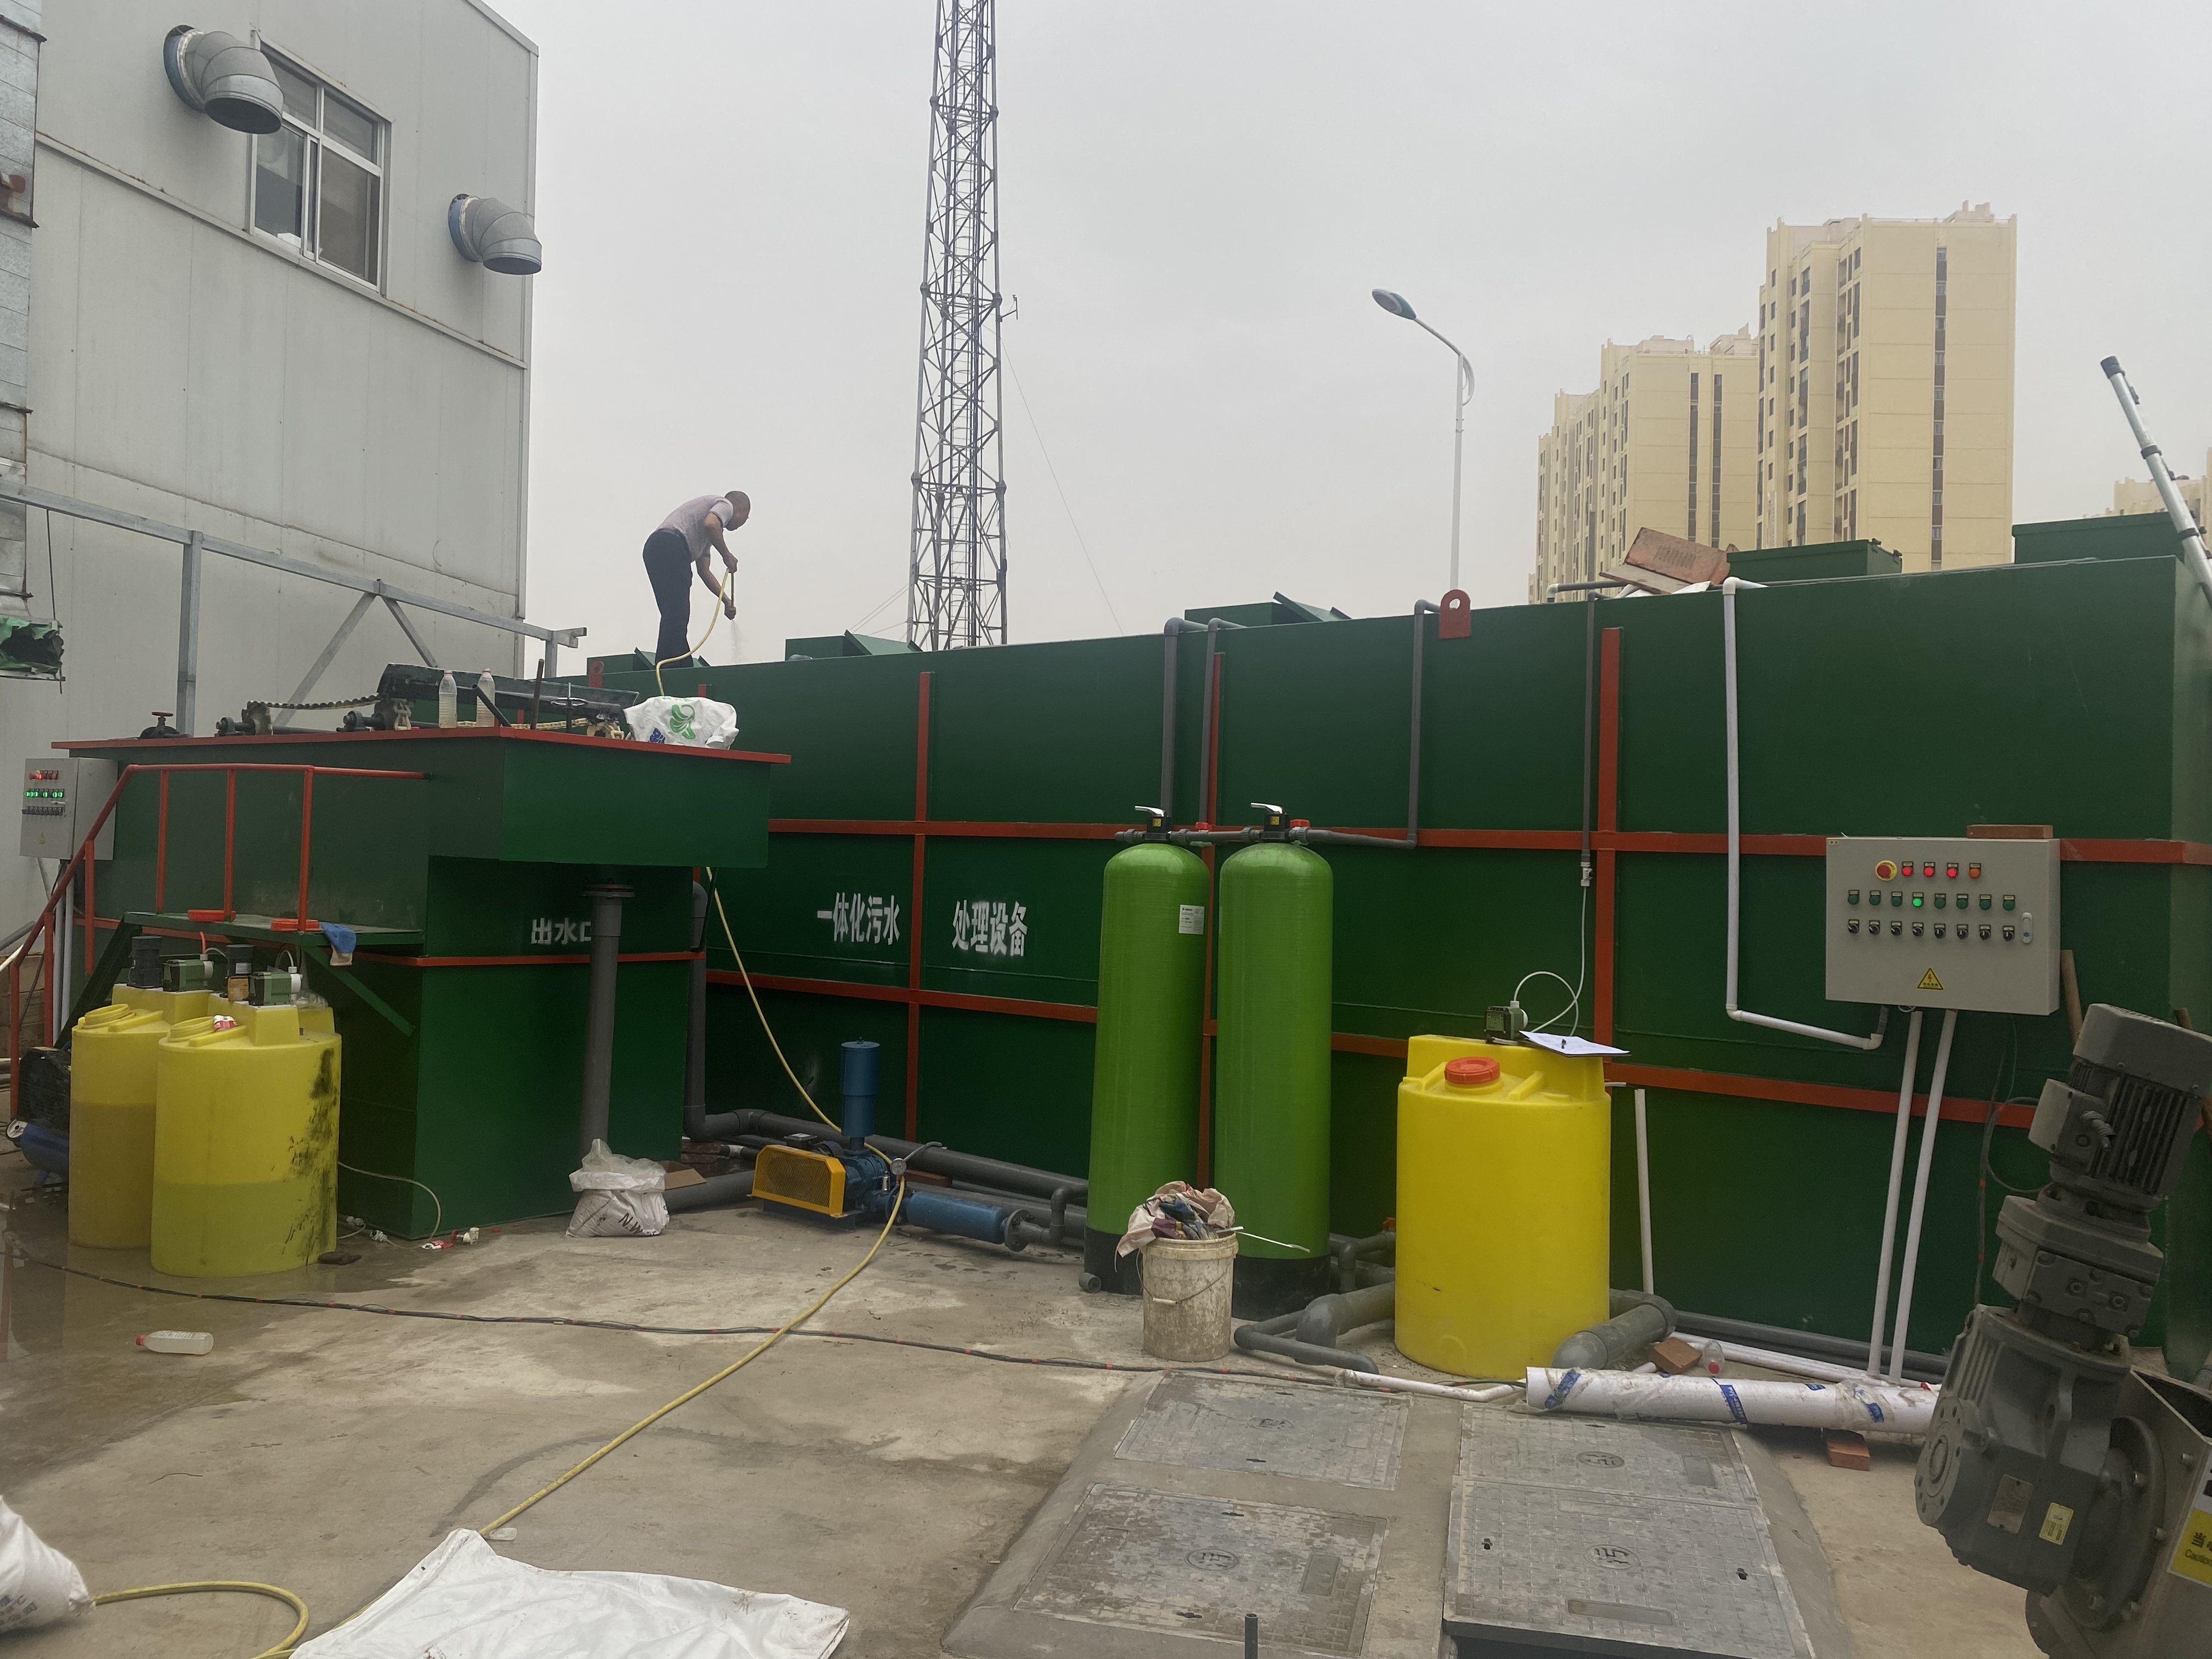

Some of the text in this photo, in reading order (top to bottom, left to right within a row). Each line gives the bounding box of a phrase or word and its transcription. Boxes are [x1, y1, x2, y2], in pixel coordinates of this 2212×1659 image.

[817, 892, 1028, 956] 一体化污水 处理设备
[1594, 1547, 1630, 1565] 污
